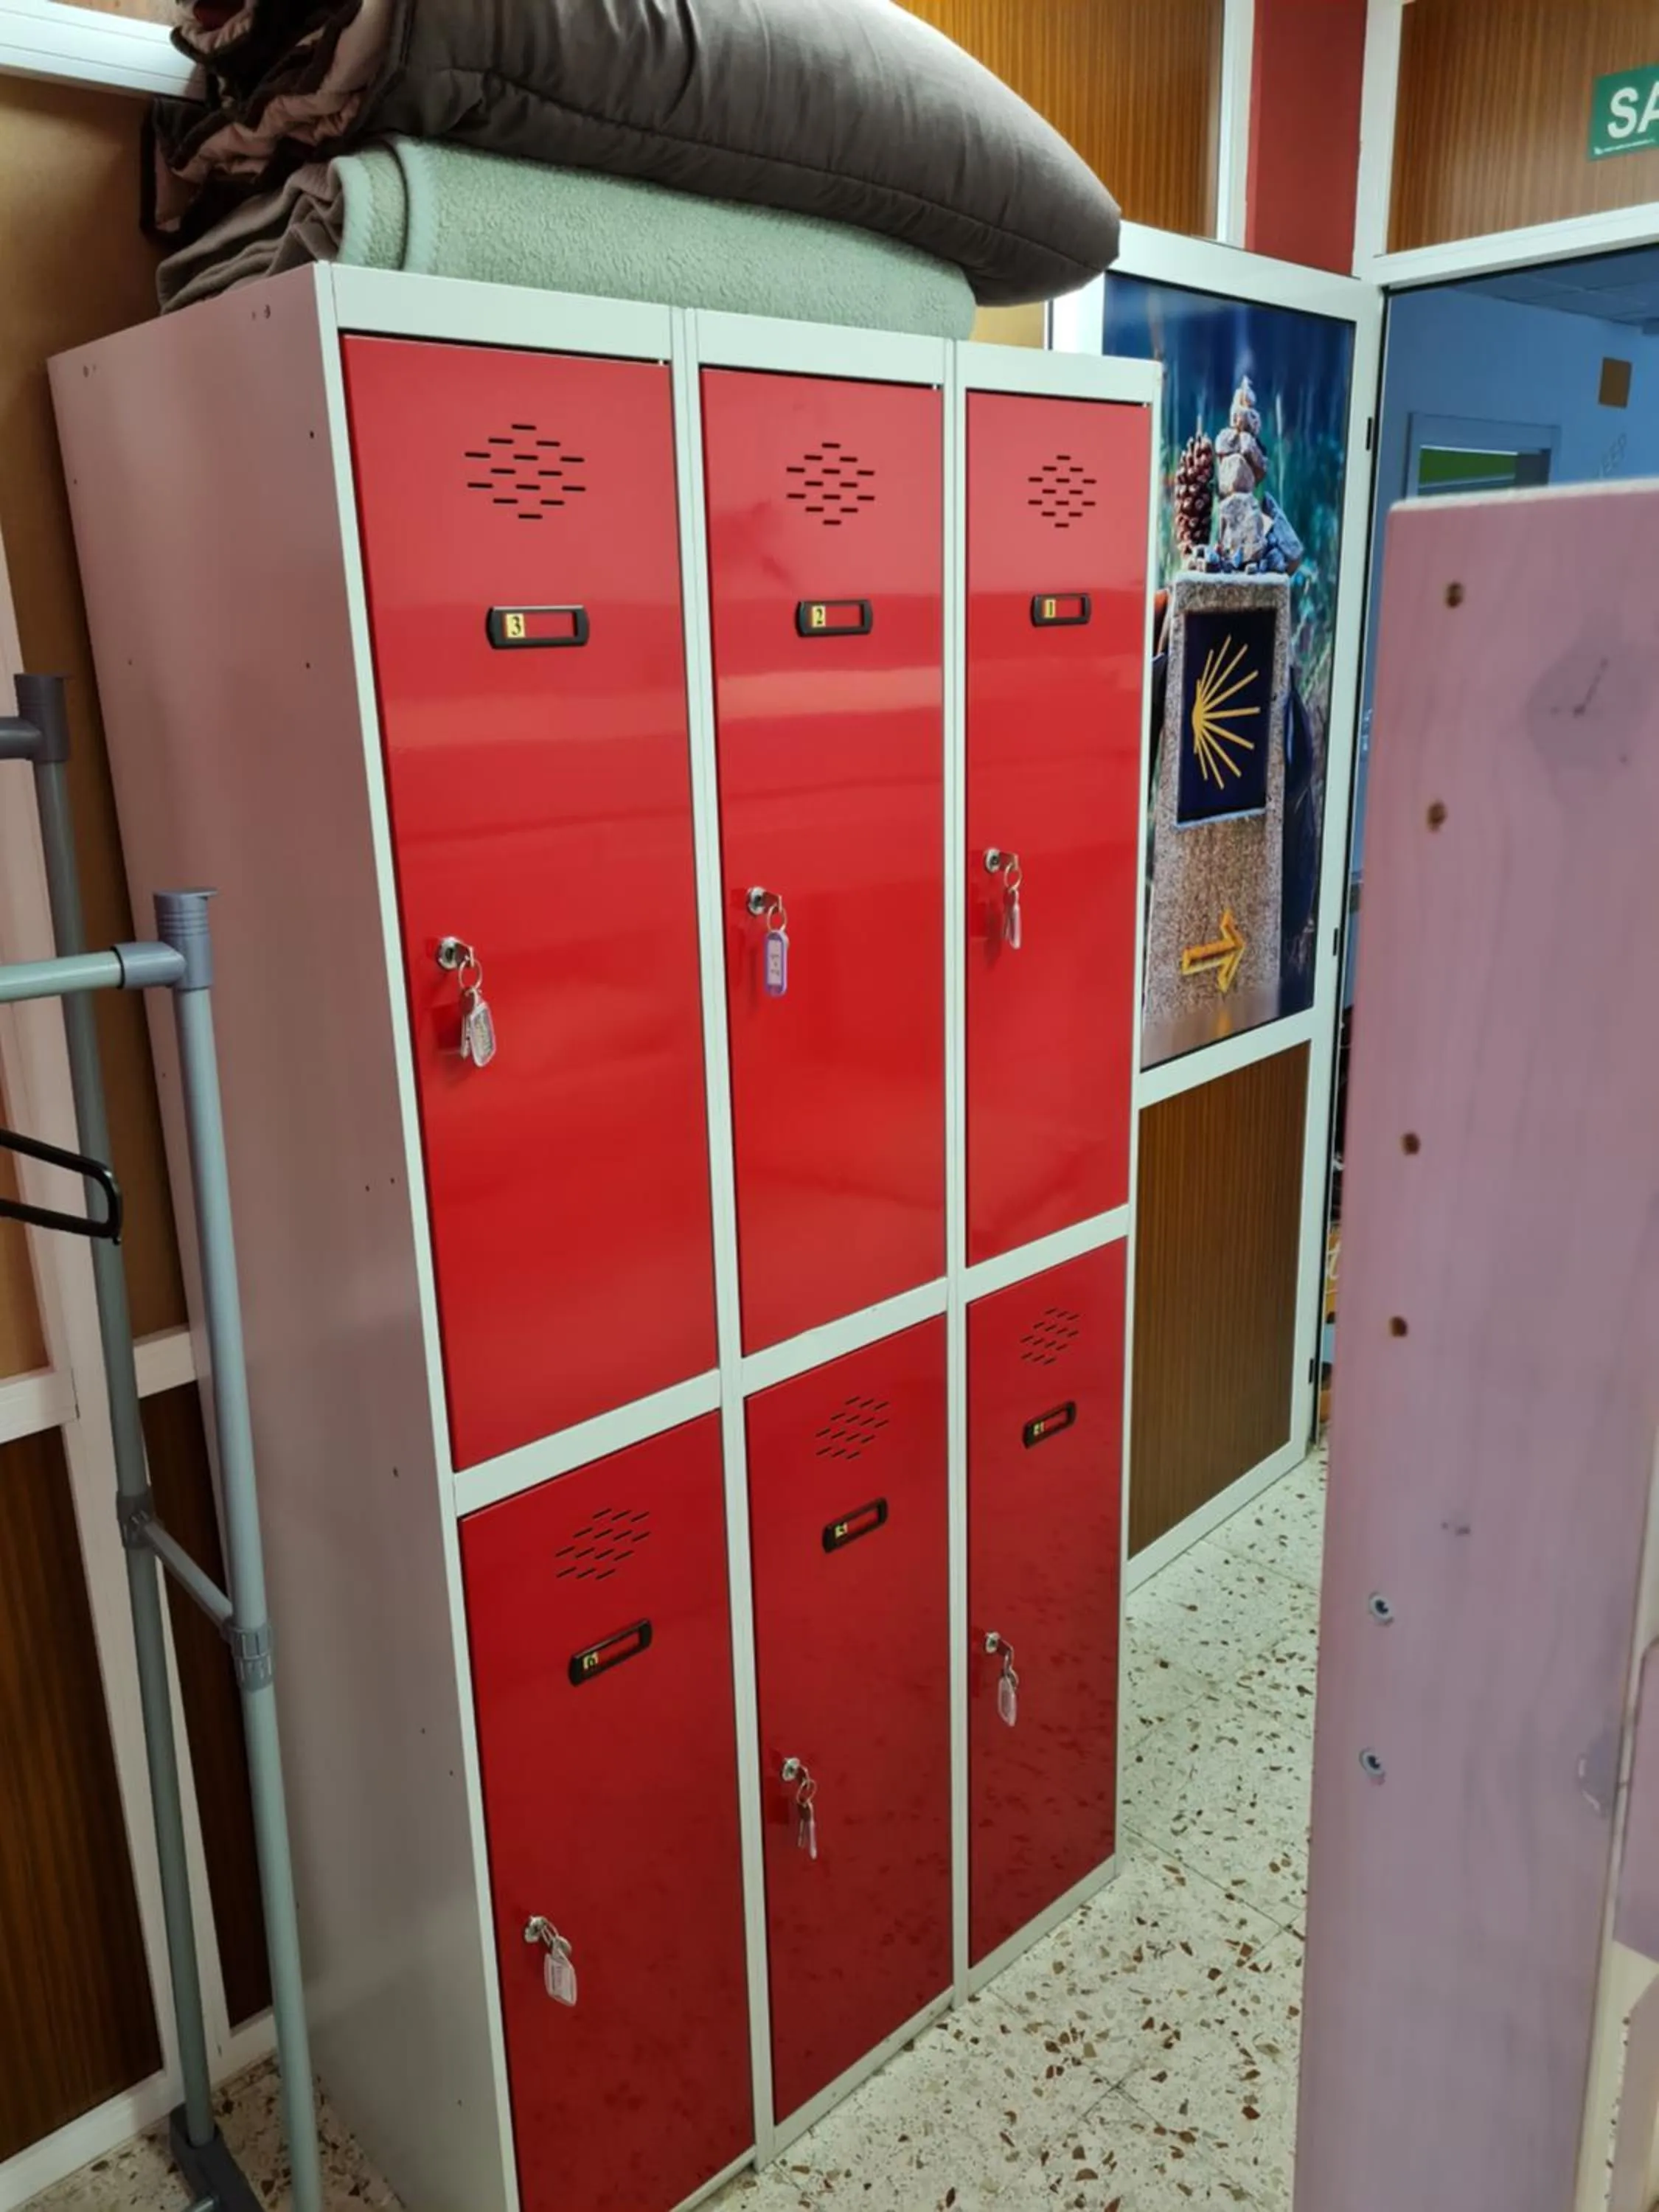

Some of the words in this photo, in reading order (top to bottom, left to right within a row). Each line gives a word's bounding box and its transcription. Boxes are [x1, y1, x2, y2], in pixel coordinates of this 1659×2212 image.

[815, 608, 824, 625] 2
[1048, 601, 1054, 616] 1
[511, 615, 521, 636] 3
